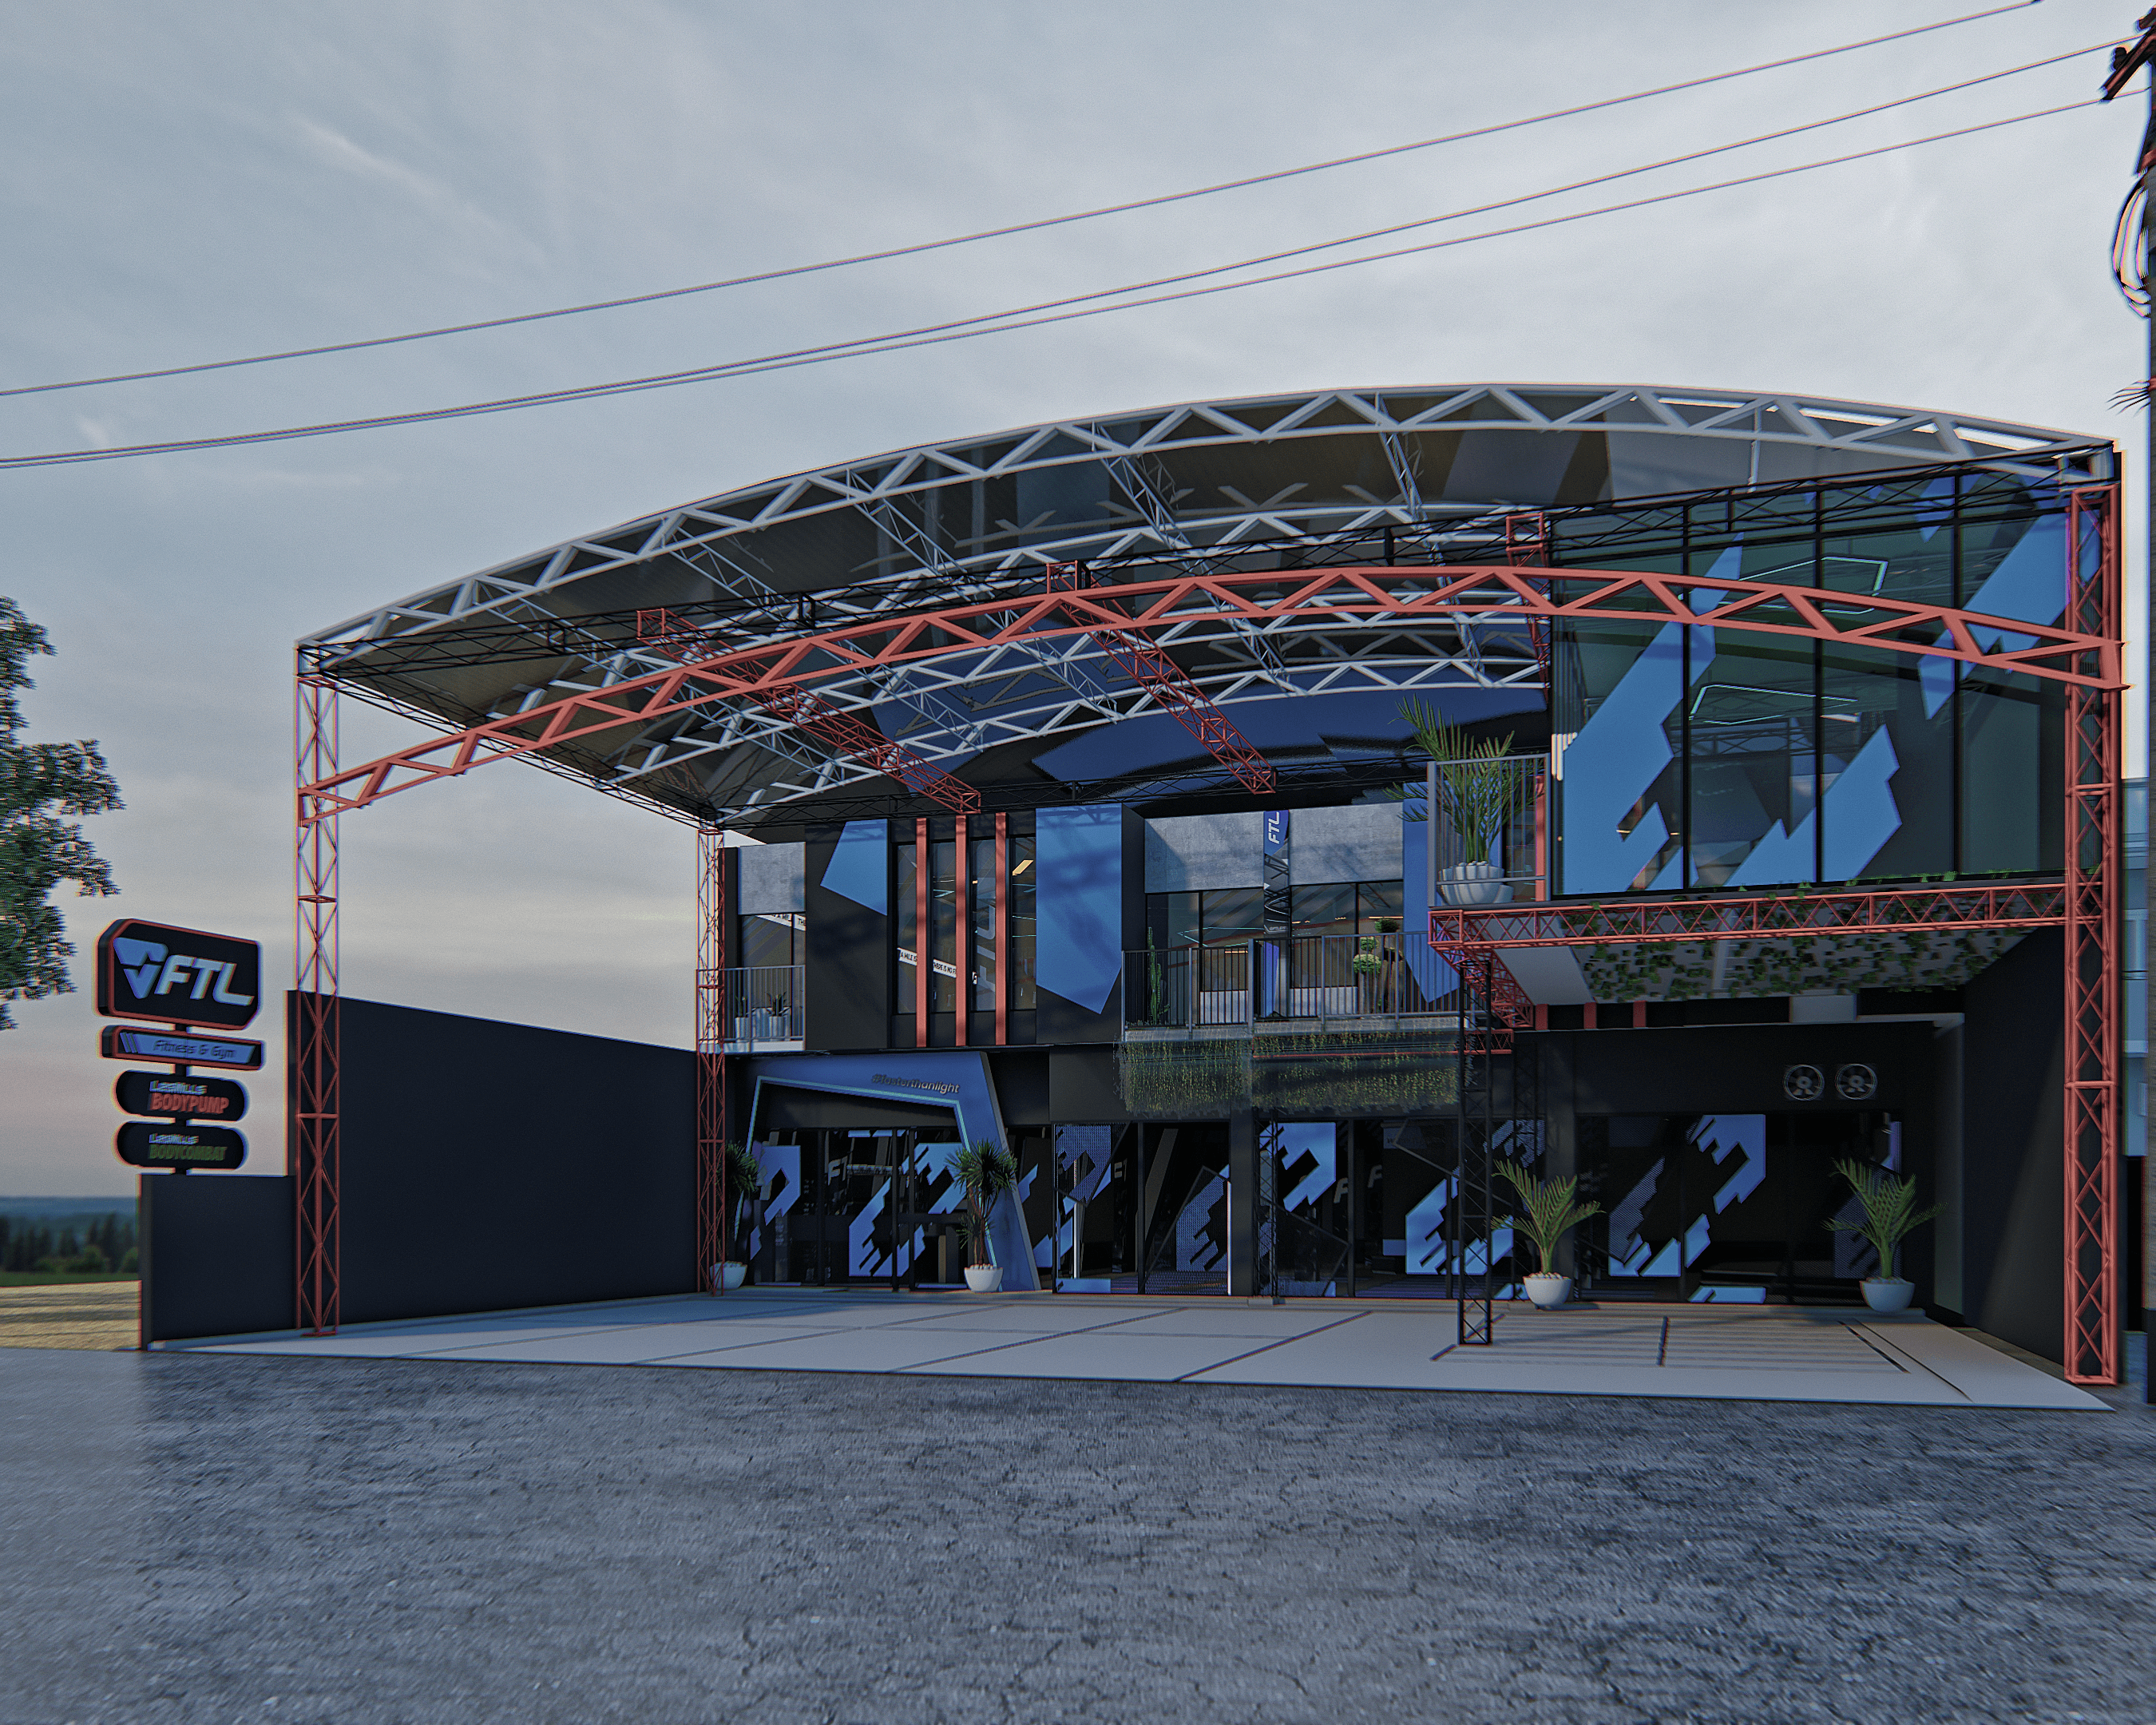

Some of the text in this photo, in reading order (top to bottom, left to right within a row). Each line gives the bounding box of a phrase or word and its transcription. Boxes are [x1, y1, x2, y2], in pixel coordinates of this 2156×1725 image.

[1268, 811, 1279, 844] FTL
[154, 954, 255, 1006] FTL
[153, 1040, 196, 1054] Fitness
[211, 1046, 236, 1059] Gym
[871, 1073, 960, 1094] #fasterthanlight
[149, 1092, 229, 1114] BODYPUMP
[149, 1144, 228, 1160] BODYCOMBAT
